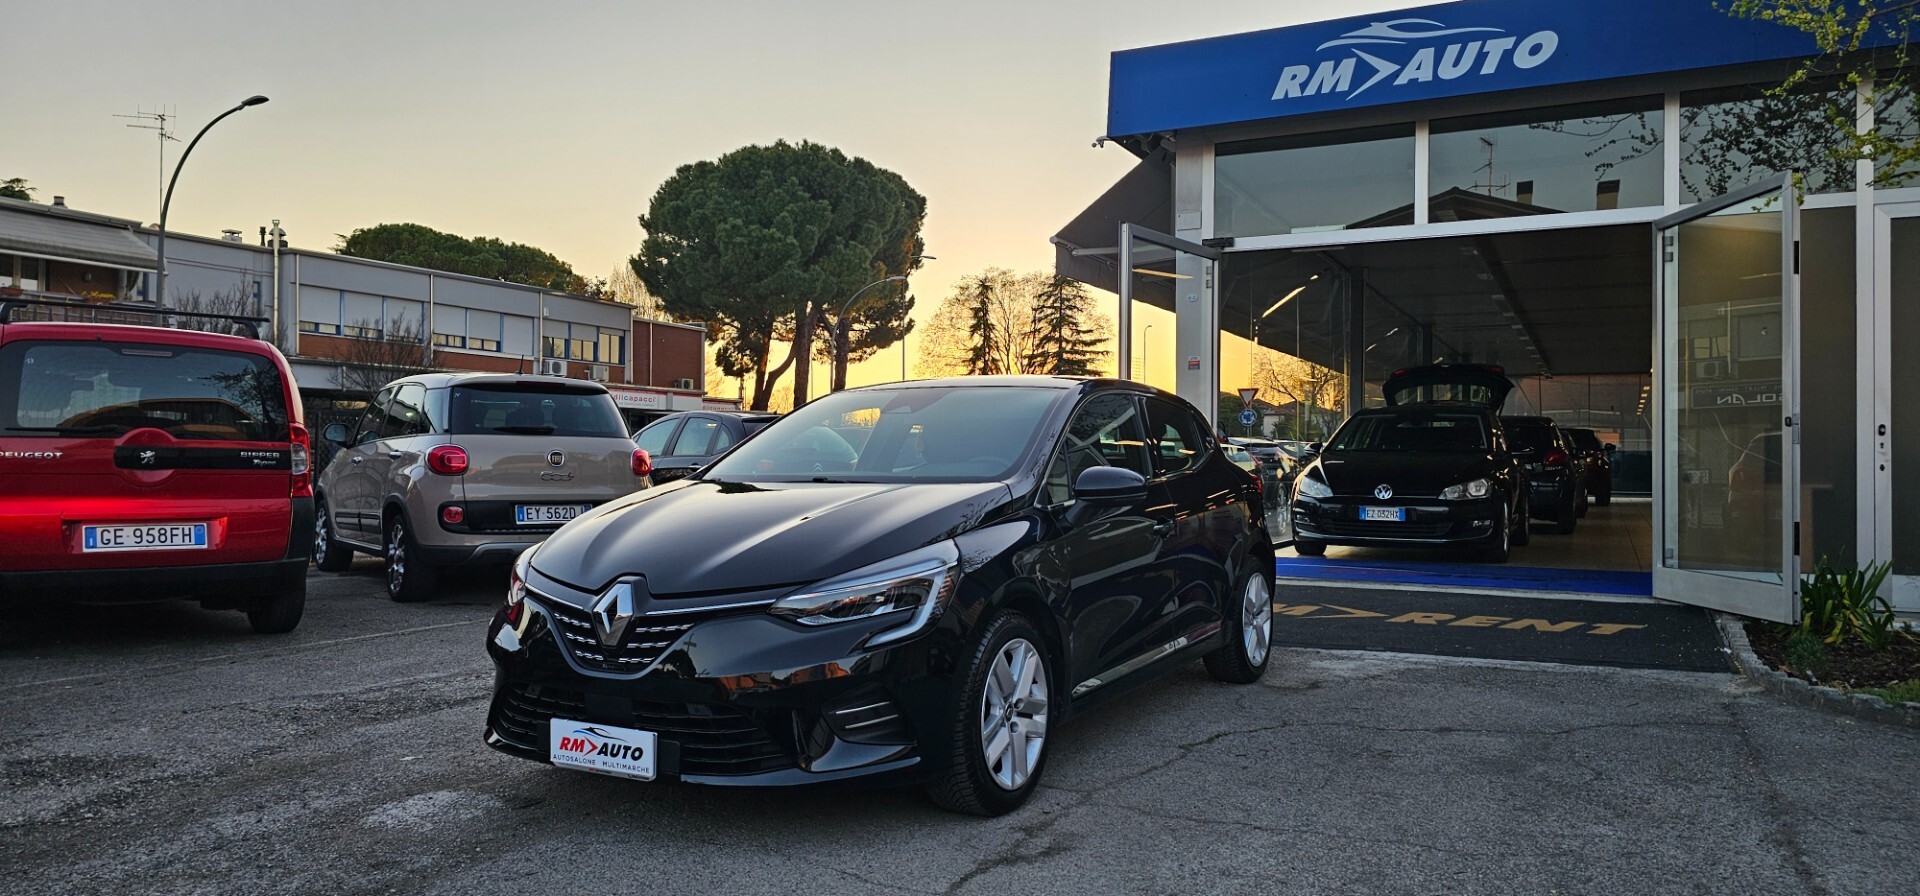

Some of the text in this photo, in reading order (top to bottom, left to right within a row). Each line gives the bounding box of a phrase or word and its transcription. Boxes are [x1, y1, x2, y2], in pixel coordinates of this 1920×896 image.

[1271, 30, 1559, 101] RM AUTO
[611, 394, 656, 403] dilcapacci
[526, 507, 540, 520] EY
[100, 528, 125, 545] GE
[133, 527, 192, 544] 958FH
[1384, 611, 1648, 635] RENT
[559, 736, 644, 761] RM AUTO
[553, 754, 596, 766] AUTOSALONE
[602, 760, 650, 773] MULTIMARCHE
